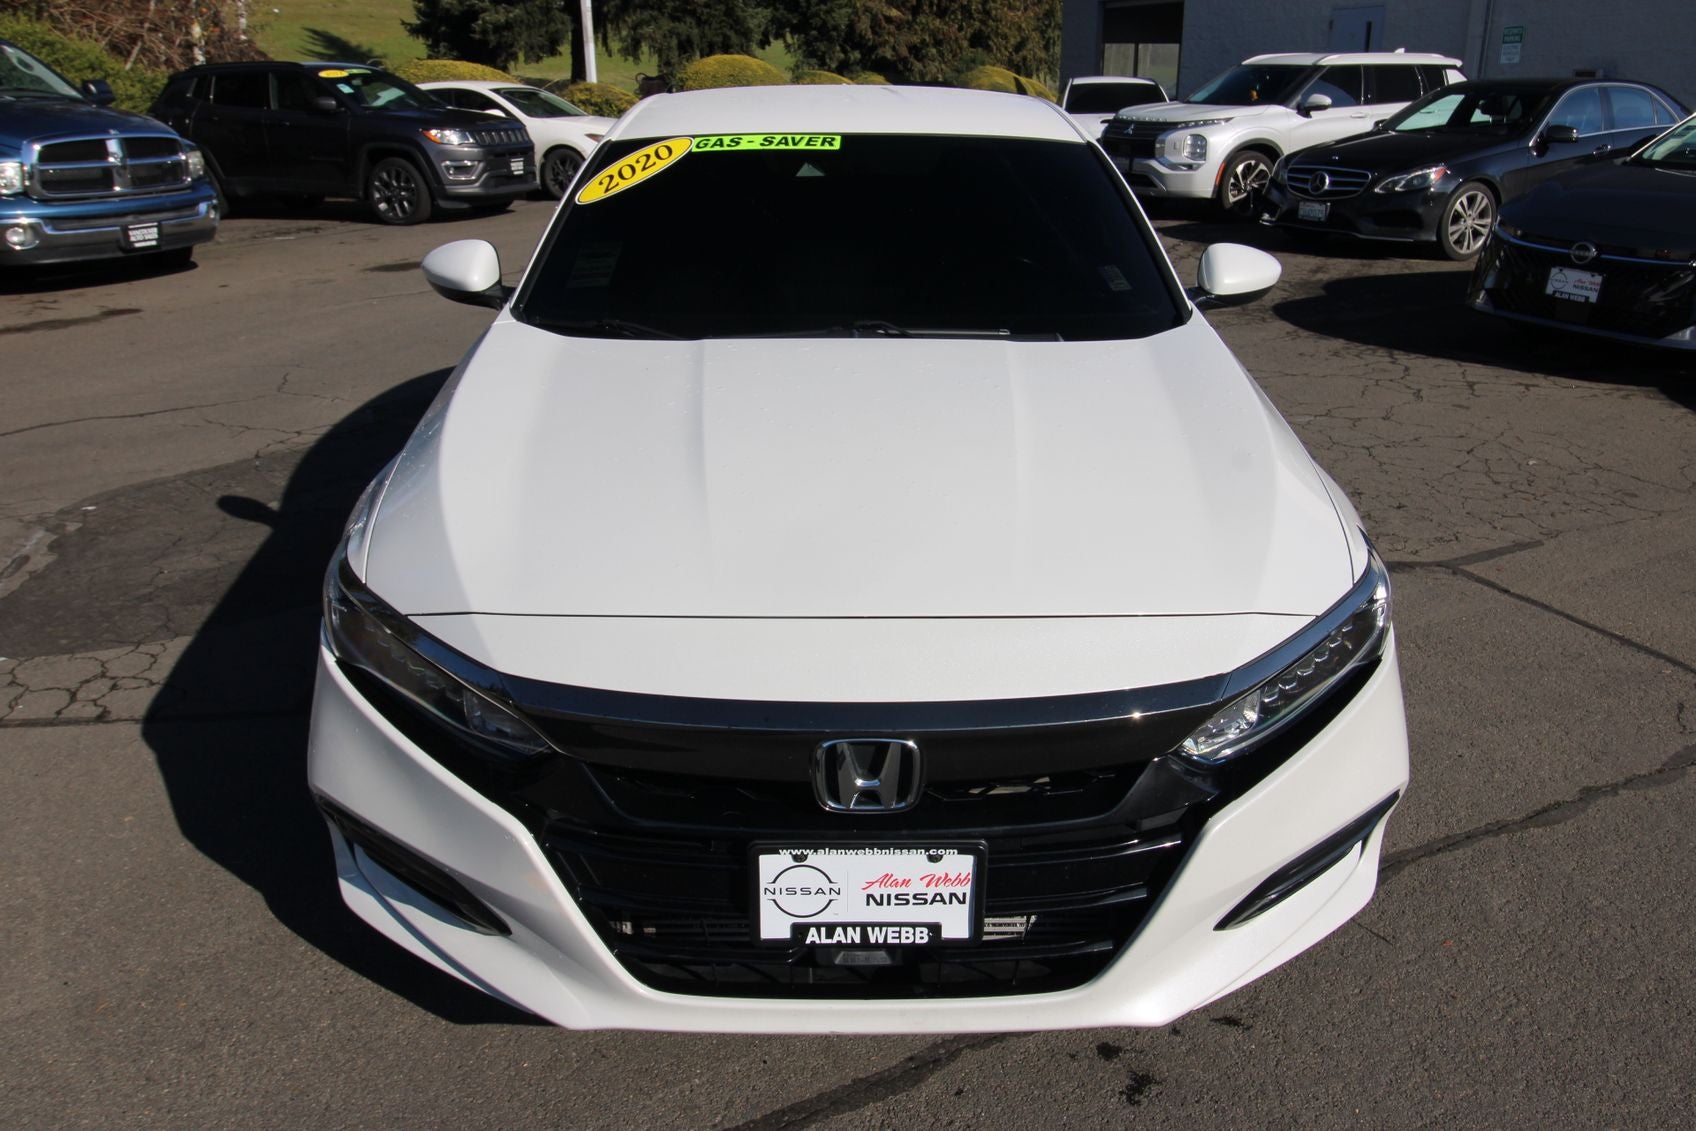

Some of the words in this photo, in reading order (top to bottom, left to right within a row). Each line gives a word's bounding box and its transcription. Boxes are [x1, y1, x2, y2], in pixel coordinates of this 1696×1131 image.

[695, 137, 742, 150] GAS
[759, 136, 835, 149] SAVER
[598, 144, 674, 194] 2020
[778, 847, 958, 857] www.alanwebbnissan.com
[861, 872, 912, 891] Alan
[919, 871, 972, 889] Webb
[764, 887, 841, 896] NISSAN
[865, 892, 967, 907] NISSAN
[805, 926, 861, 944] ALAN
[866, 926, 930, 944] WEBB
